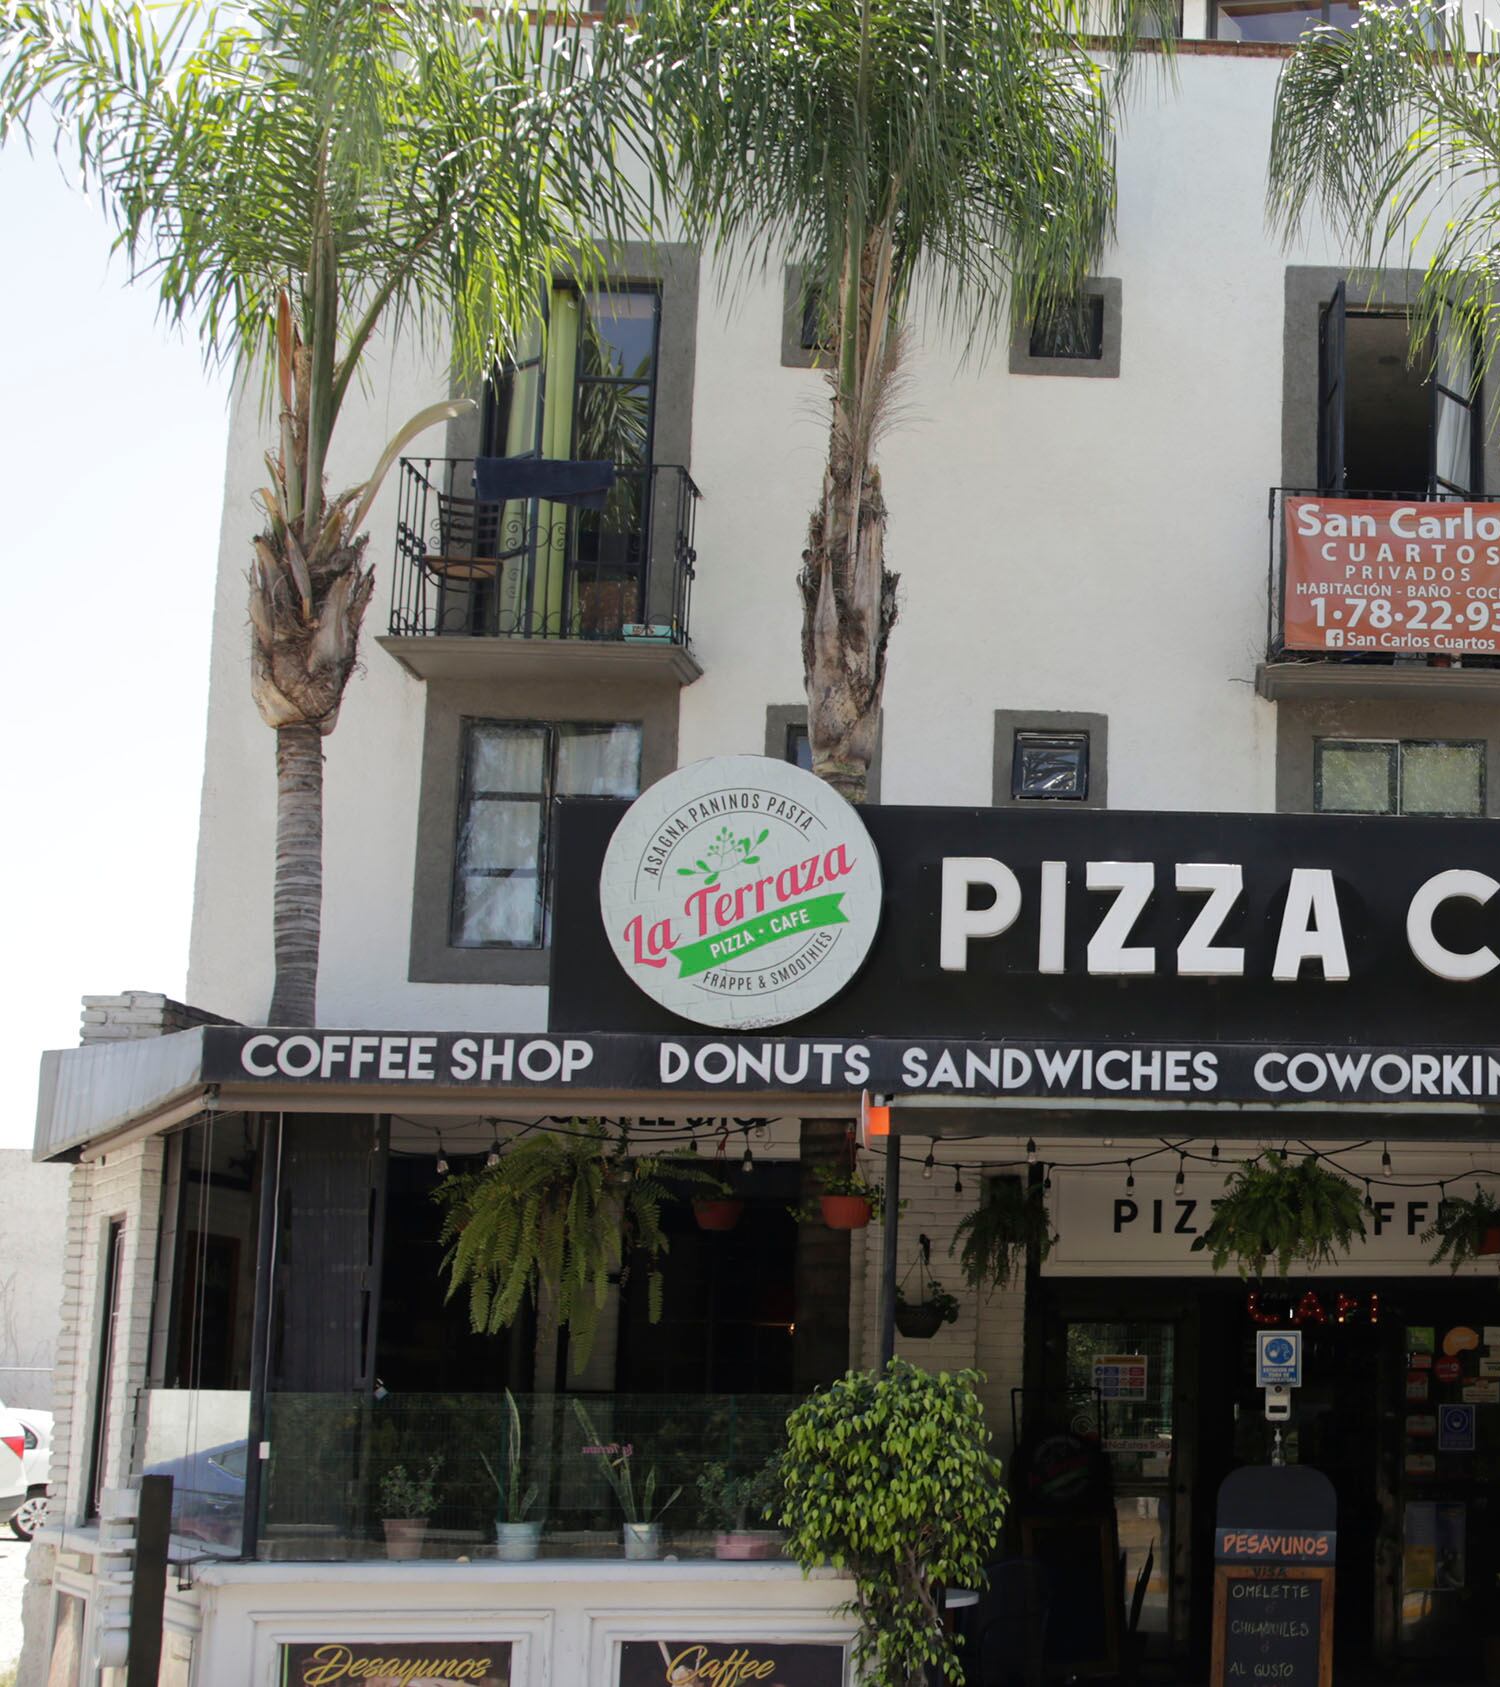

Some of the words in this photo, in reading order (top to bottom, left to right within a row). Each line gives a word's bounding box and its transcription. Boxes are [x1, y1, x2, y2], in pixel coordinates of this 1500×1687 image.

[1297, 503, 1376, 538] San
[1321, 542, 1500, 566] CUARTOS
[1296, 583, 1392, 597] HABITACIÓN
[1407, 583, 1451, 598] BAÑO
[1345, 565, 1471, 582] PRIVADOS
[1347, 632, 1376, 647] San
[1380, 632, 1430, 648] Carlos
[1434, 634, 1495, 650] Cuartos
[643, 818, 689, 876] ASAGNA
[688, 793, 760, 823] PANINOS
[767, 796, 814, 831] PASTA
[623, 914, 681, 969] La
[684, 843, 857, 938] Terraza
[940, 856, 1350, 981] PIZZA
[710, 930, 755, 958] PIZZA
[769, 908, 810, 935] CAFE
[703, 971, 752, 991] FRAPPE
[758, 979, 766, 989] &
[771, 930, 833, 985] SMOOTHIES
[241, 1035, 436, 1079] COFFEE
[451, 1039, 594, 1082] SHOP
[660, 1043, 870, 1084] DONUTS
[902, 1047, 1218, 1091] SANDWICHES
[1222, 1534, 1329, 1557] DESAYUNOS
[1231, 1583, 1311, 1599] OMELETTE
[302, 1644, 494, 1687] Desayunos
[1228, 1661, 1247, 1675] AL
[1253, 1661, 1294, 1678] GUSTO
